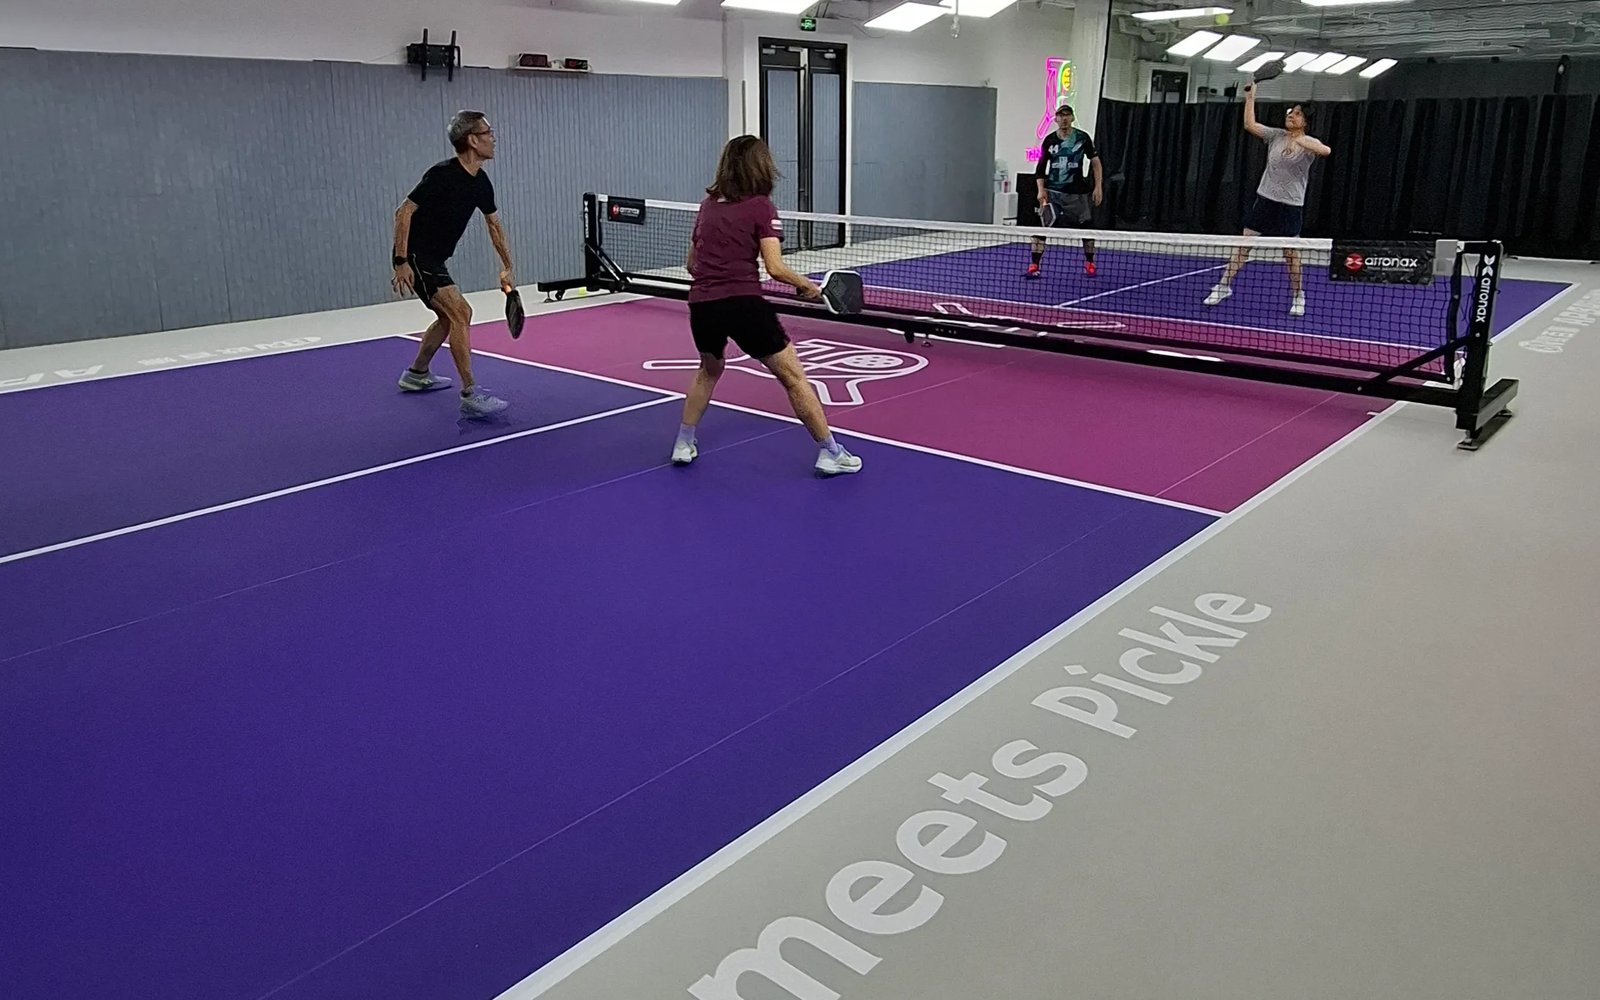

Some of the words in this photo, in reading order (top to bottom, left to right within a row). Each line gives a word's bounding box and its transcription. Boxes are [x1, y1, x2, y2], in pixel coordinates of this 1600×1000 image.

[1475, 277, 1492, 323] arronax
[687, 738, 1088, 1000] meets
[1031, 592, 1272, 740] Pickle
